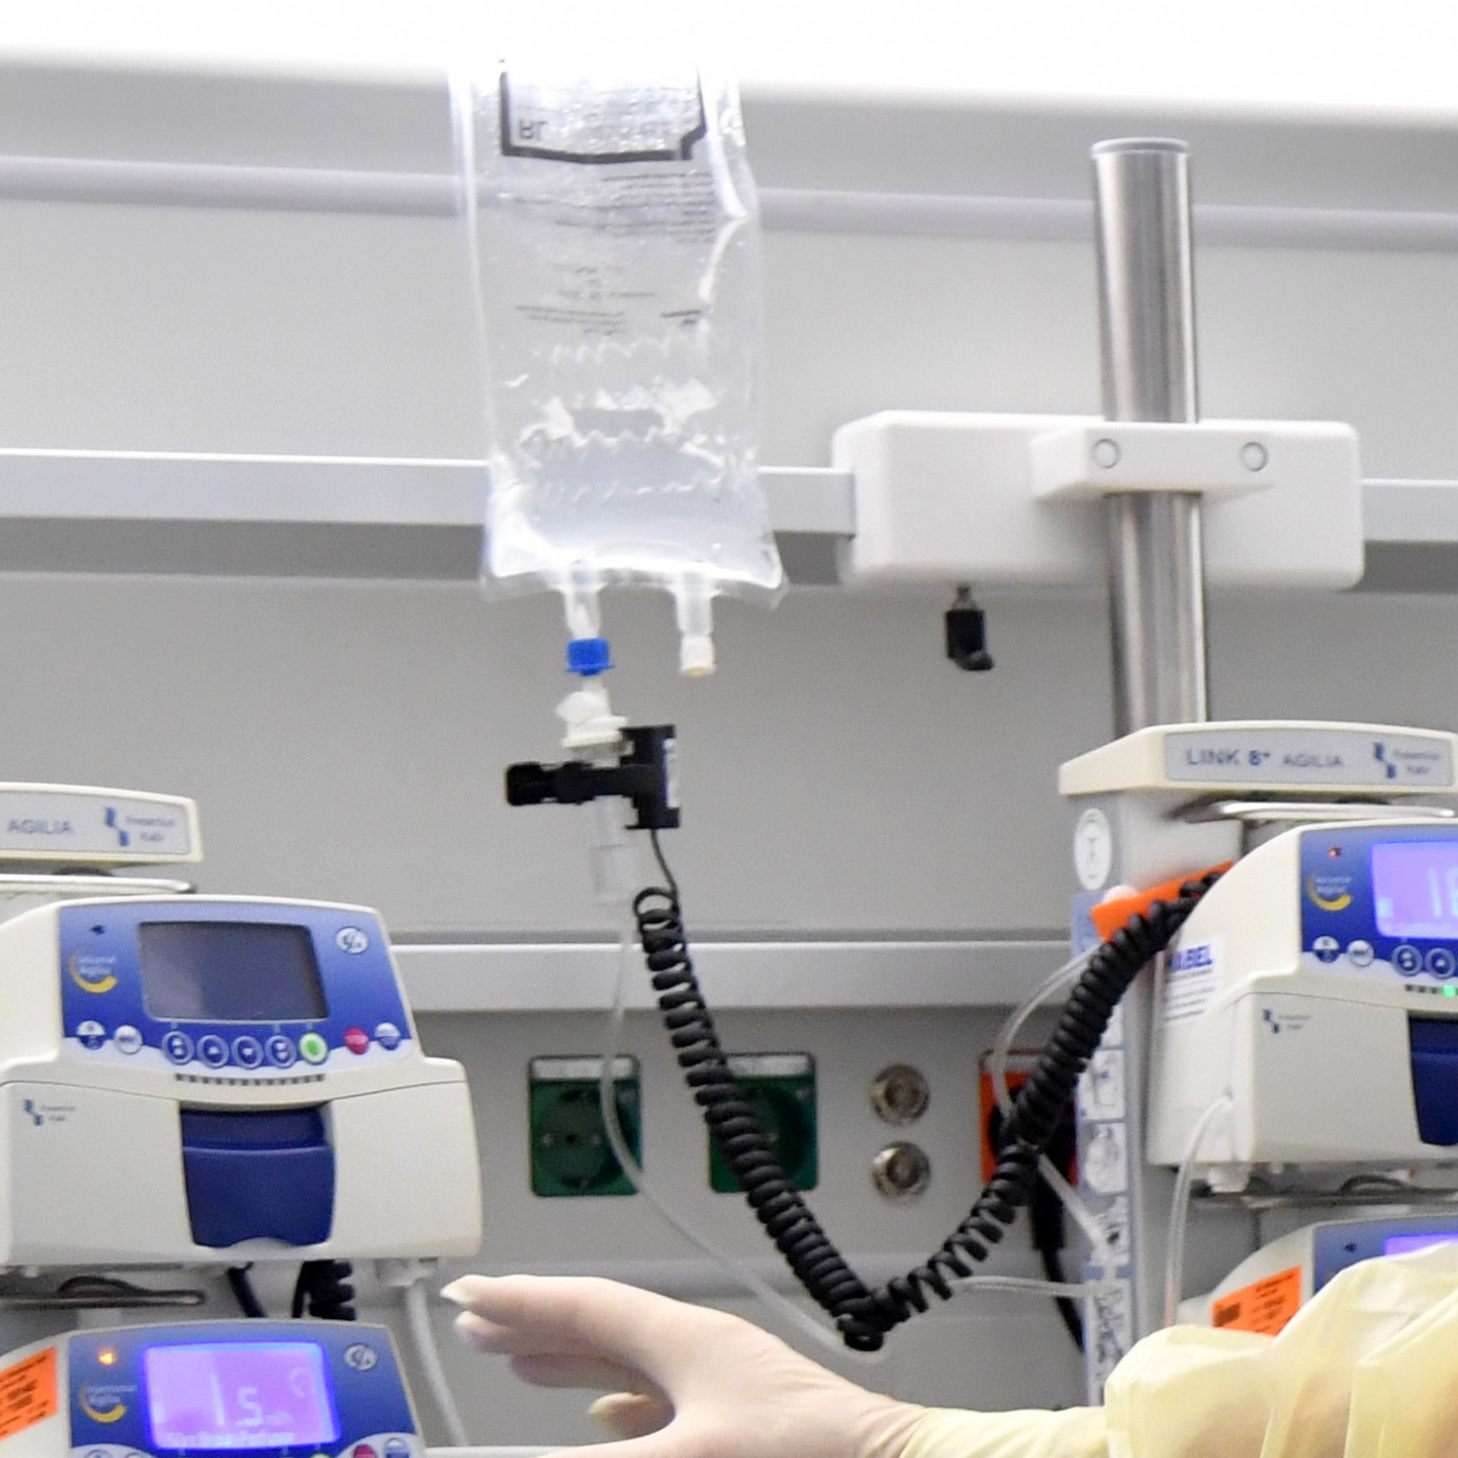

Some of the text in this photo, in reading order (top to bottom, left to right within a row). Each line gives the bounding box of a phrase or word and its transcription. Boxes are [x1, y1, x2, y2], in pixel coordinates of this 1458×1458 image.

[1185, 748, 1240, 766] LINK
[1282, 753, 1345, 769] AGILIA
[8, 818, 74, 836] AGILIA
